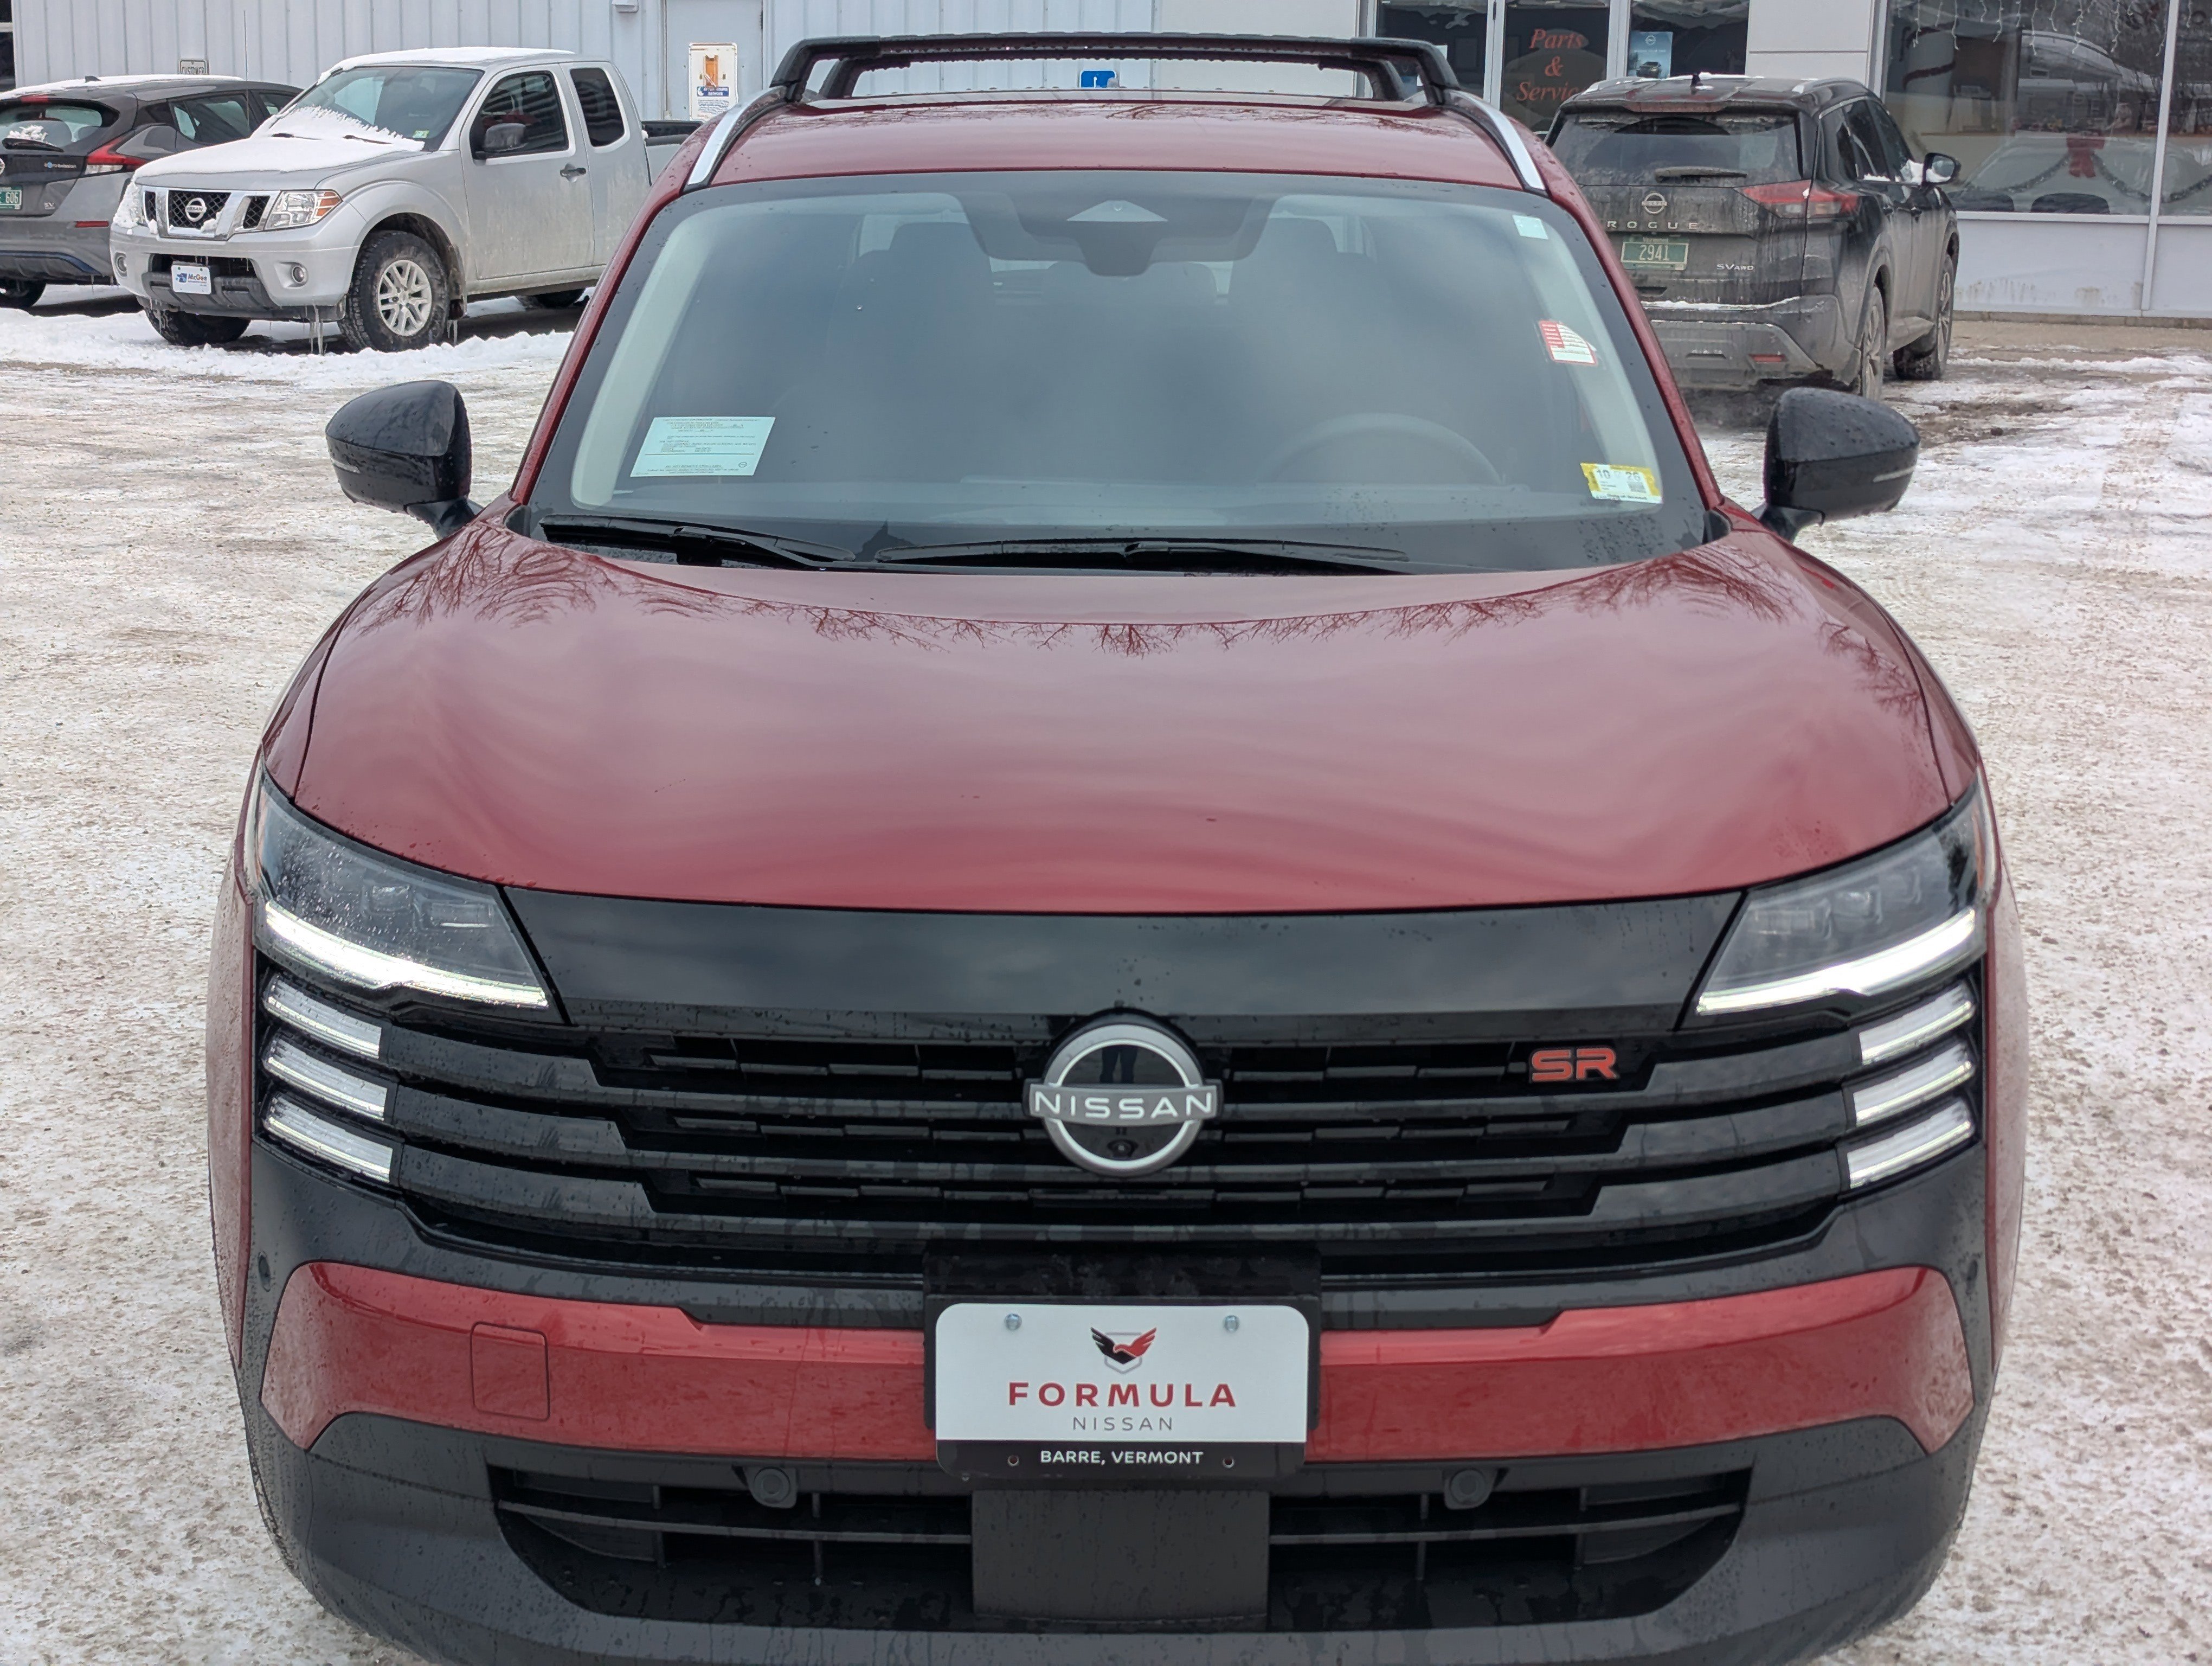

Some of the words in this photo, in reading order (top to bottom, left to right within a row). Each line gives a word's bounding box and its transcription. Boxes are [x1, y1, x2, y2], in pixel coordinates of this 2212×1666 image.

[1529, 28, 1583, 49] Parts
[1545, 56, 1564, 76] &
[1516, 81, 1585, 101] Servic
[1607, 220, 1699, 229] ROGUE
[1639, 244, 1669, 261] 2941
[1596, 470, 1611, 479] 10
[1625, 471, 1641, 482] 26
[1532, 1047, 1618, 1082] SR
[1034, 1090, 1212, 1120] NISSAN
[1008, 1381, 1237, 1407] FORMULA
[1072, 1416, 1173, 1431] NISSAN
[1040, 1450, 1106, 1465] BARRE,
[1111, 1451, 1204, 1464] VERMONT
